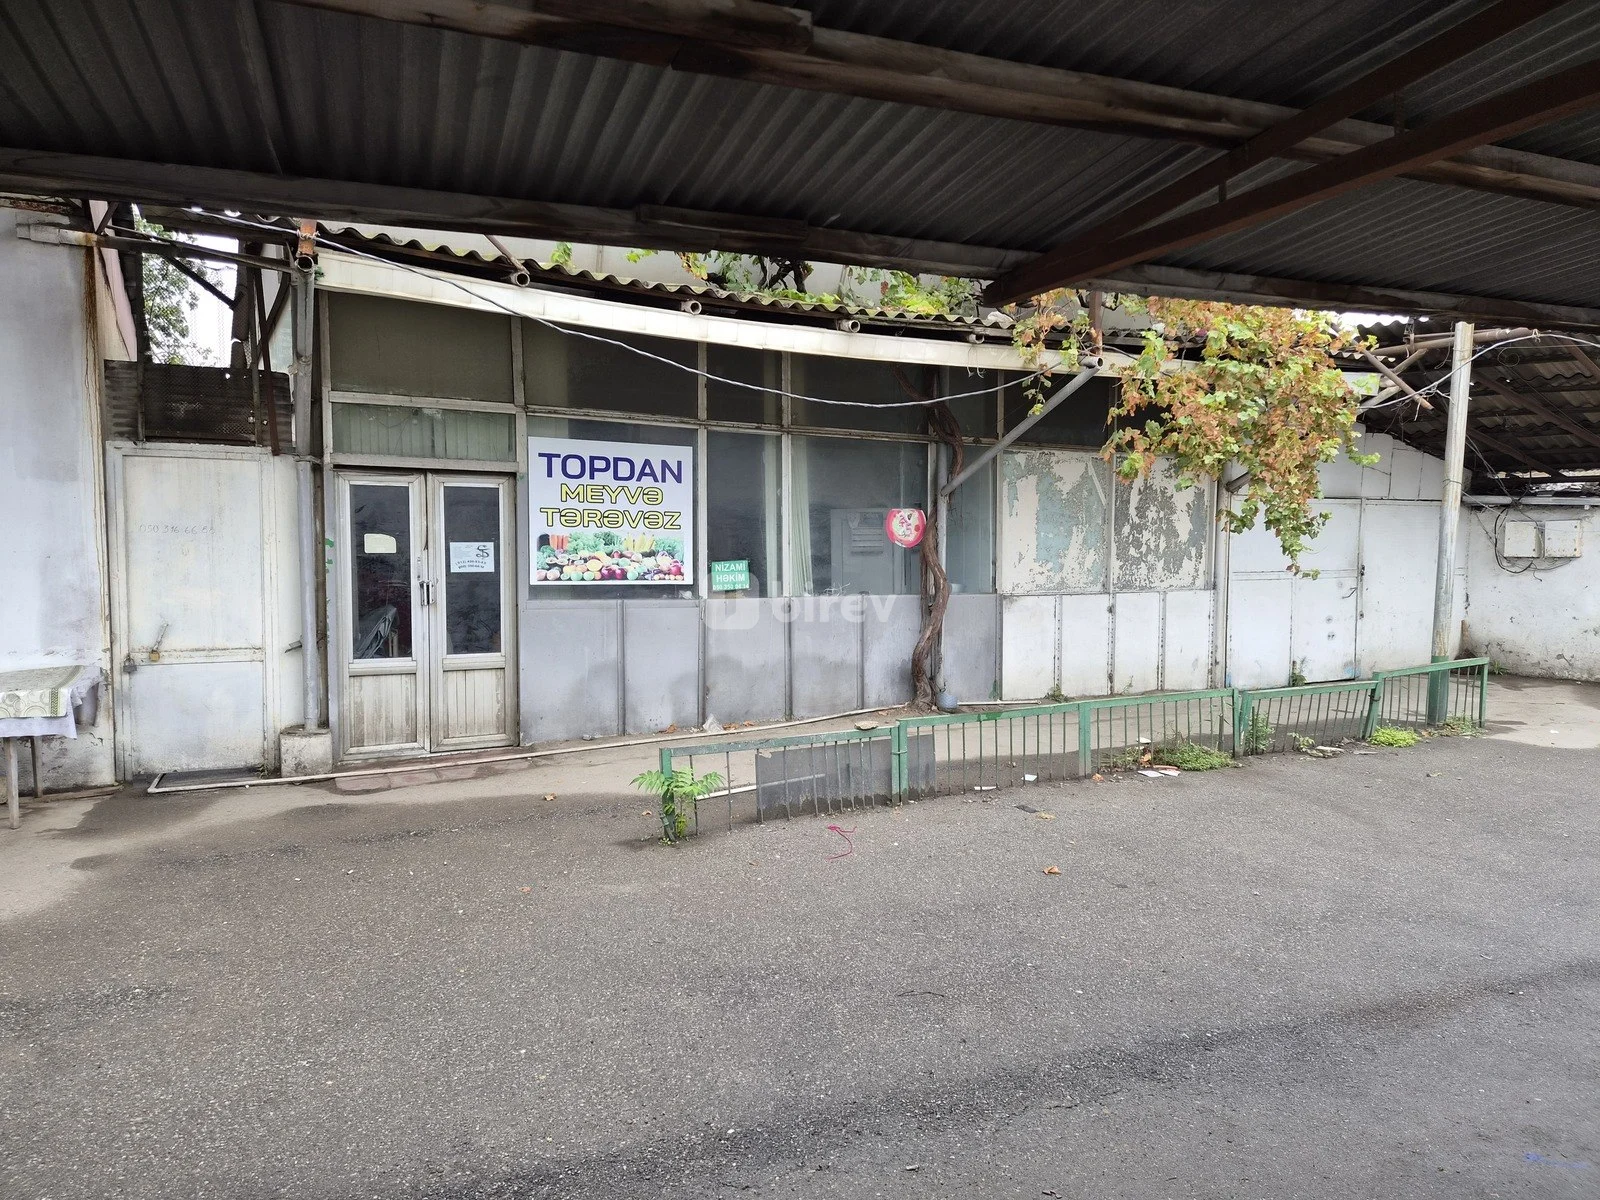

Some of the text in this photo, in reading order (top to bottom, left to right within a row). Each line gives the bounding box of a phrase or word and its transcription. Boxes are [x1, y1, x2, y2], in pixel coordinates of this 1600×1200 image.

[538, 452, 682, 484] TOPDAN
[561, 483, 663, 505] MEYVƏ
[540, 507, 681, 530] TƏRƏVƏZ
